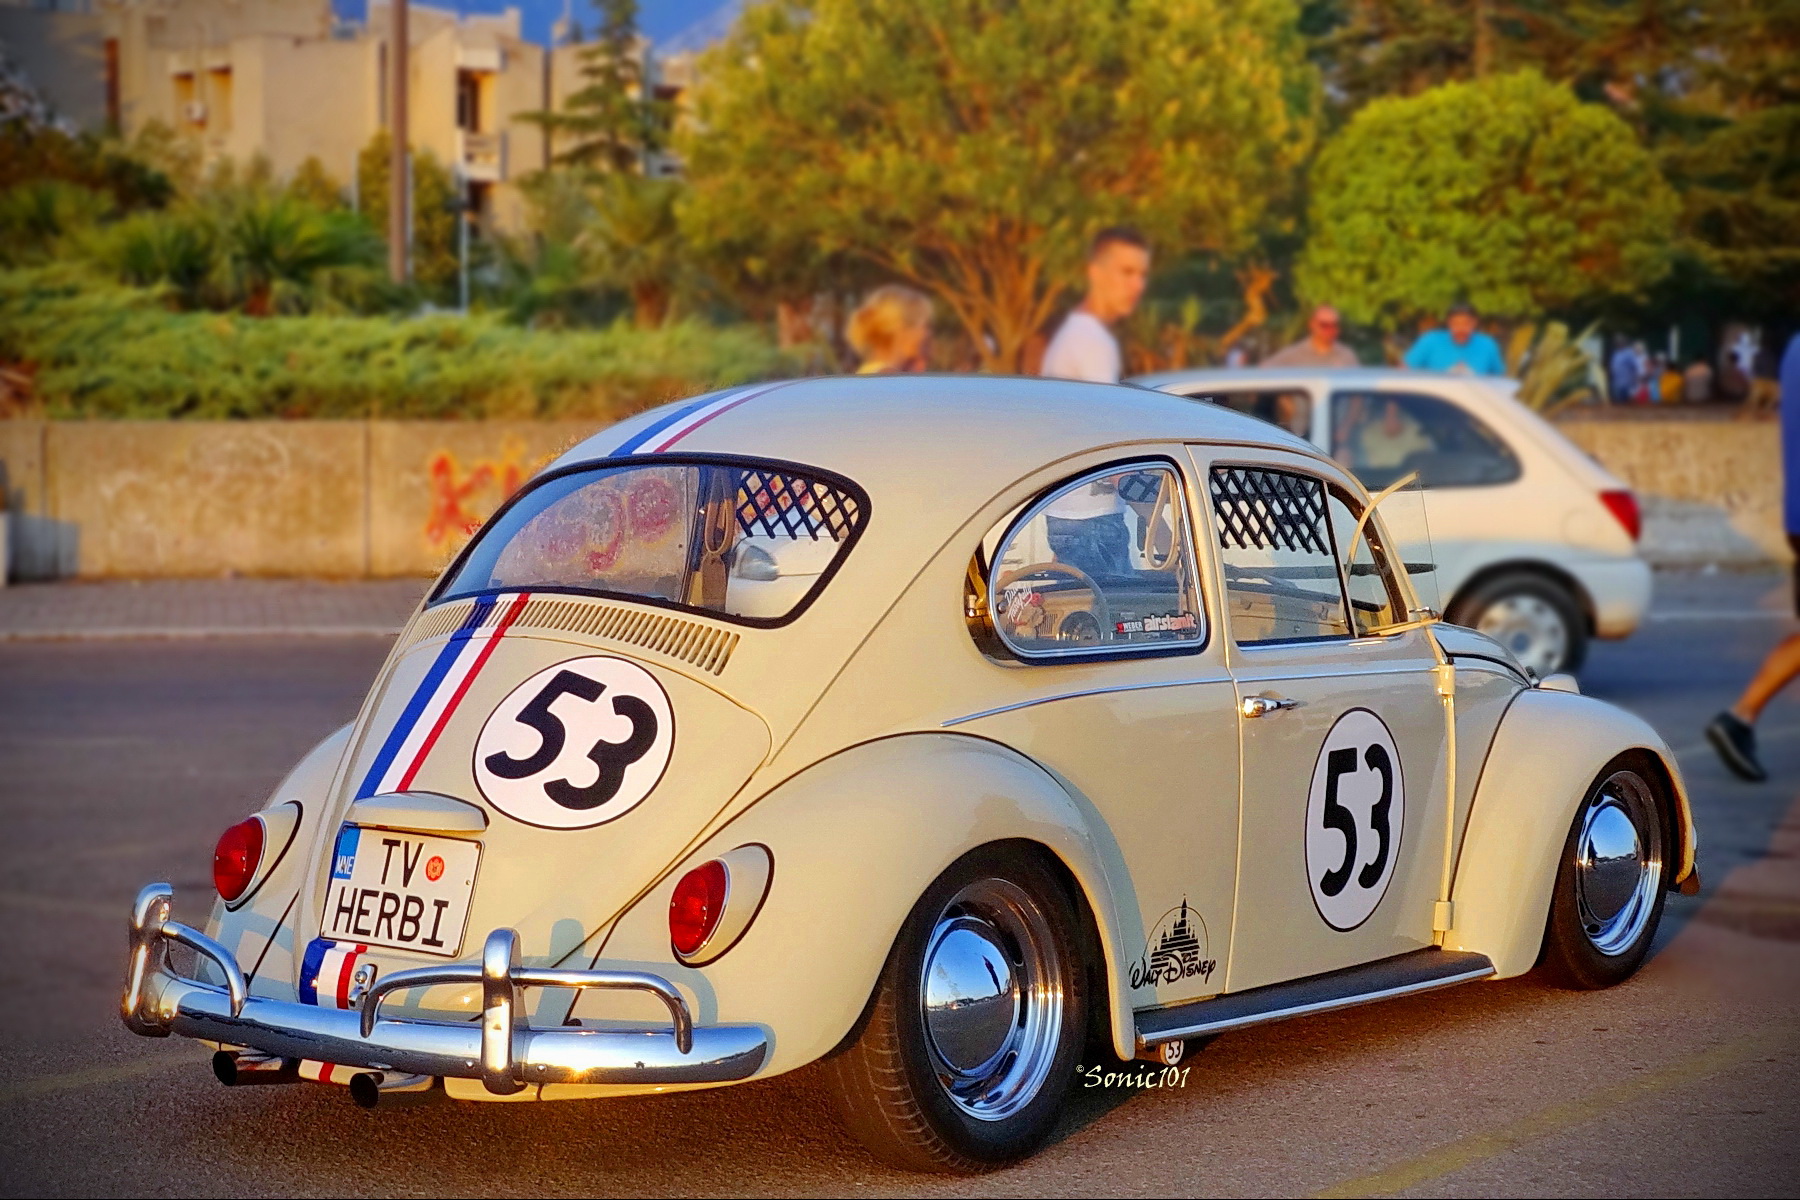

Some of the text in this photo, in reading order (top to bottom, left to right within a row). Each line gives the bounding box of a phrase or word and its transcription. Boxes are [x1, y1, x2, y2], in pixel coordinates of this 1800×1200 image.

[1123, 621, 1143, 632] WEBER
[485, 669, 658, 811] 53
[1320, 743, 1393, 897] 53
[333, 855, 355, 875] MNE
[381, 838, 424, 888] TV
[332, 886, 449, 948] HERBI
[1167, 1039, 1181, 1059] 53
